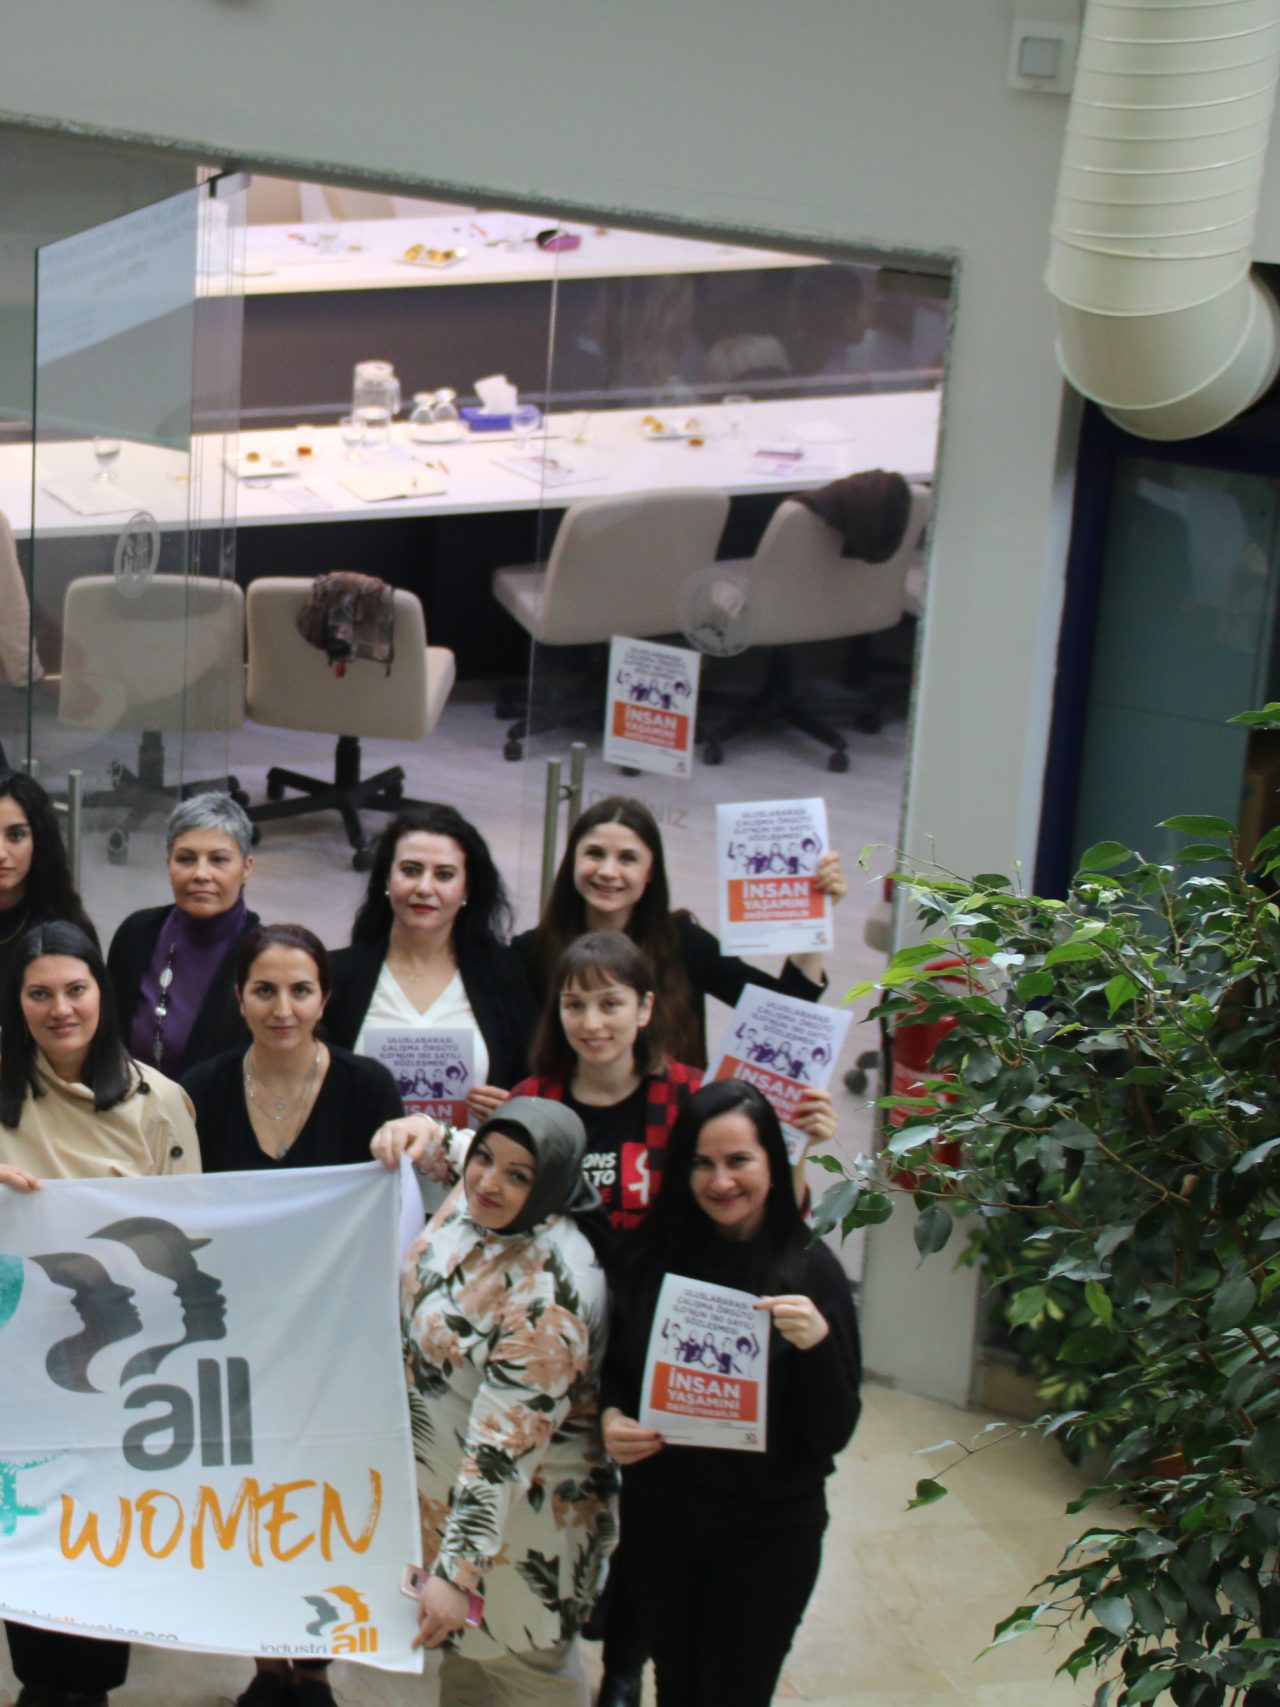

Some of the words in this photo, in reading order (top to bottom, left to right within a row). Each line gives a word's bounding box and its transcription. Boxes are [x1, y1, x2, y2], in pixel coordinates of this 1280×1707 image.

[582, 1152, 616, 1169] ONS
[122, 1356, 254, 1472] all
[59, 1468, 383, 1570] WOMEN
